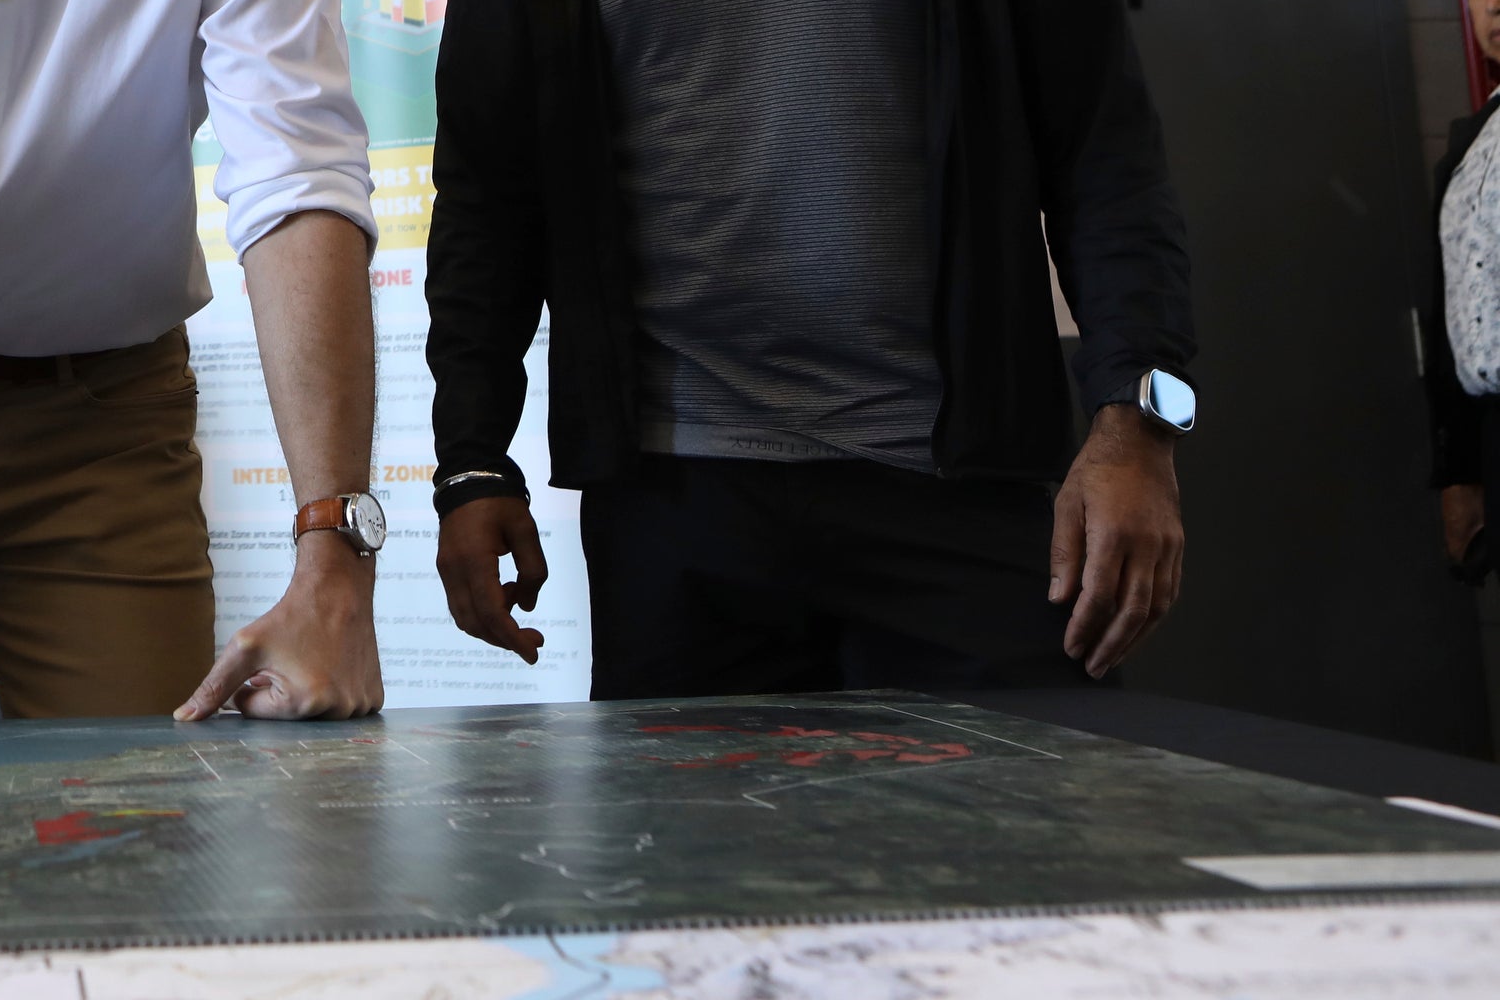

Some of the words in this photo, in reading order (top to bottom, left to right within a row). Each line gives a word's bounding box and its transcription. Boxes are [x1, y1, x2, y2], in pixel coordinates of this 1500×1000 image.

[371, 194, 423, 217] RISK
[790, 442, 821, 456] GET
[383, 464, 436, 482] ZONE
[405, 529, 420, 538] fire
[422, 530, 432, 538] to
